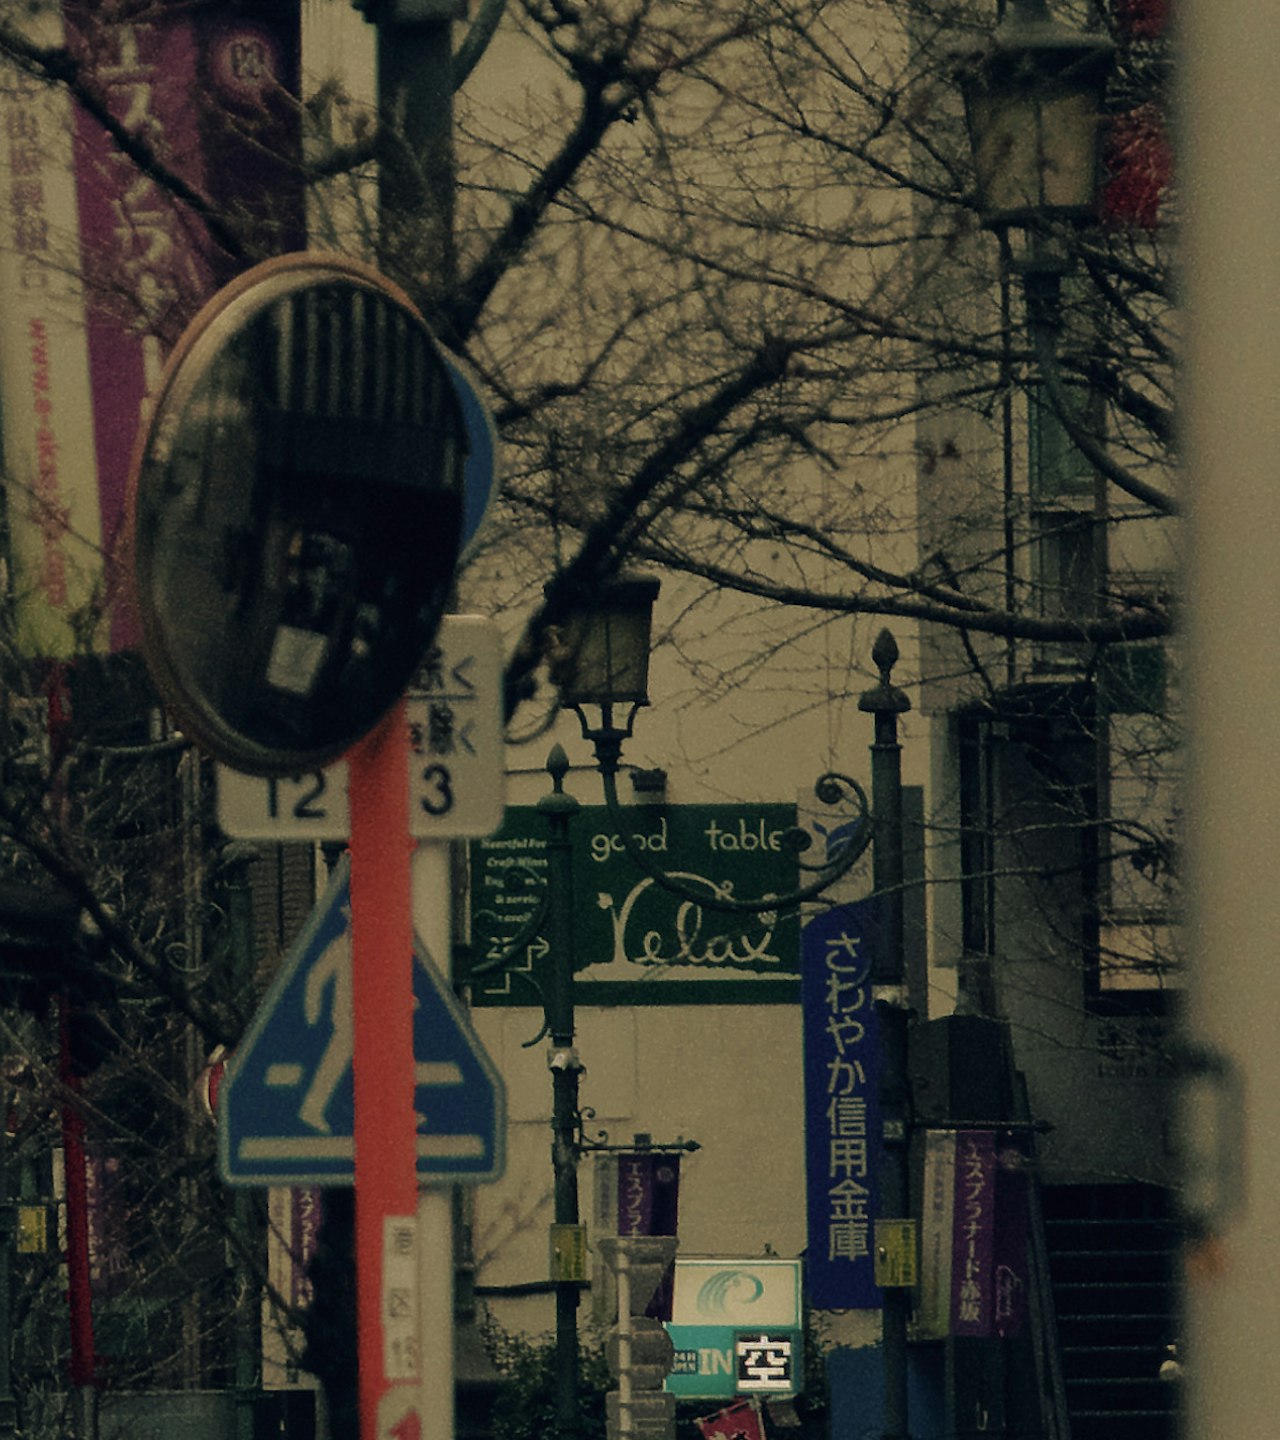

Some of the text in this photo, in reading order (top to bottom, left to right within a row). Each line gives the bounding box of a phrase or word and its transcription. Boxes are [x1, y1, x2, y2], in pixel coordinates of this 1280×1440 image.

[592, 817, 785, 862] good table
[825, 932, 869, 1262] さわやか信用金庫
[697, 1348, 733, 1375] IN
[736, 1334, 791, 1389] 空
